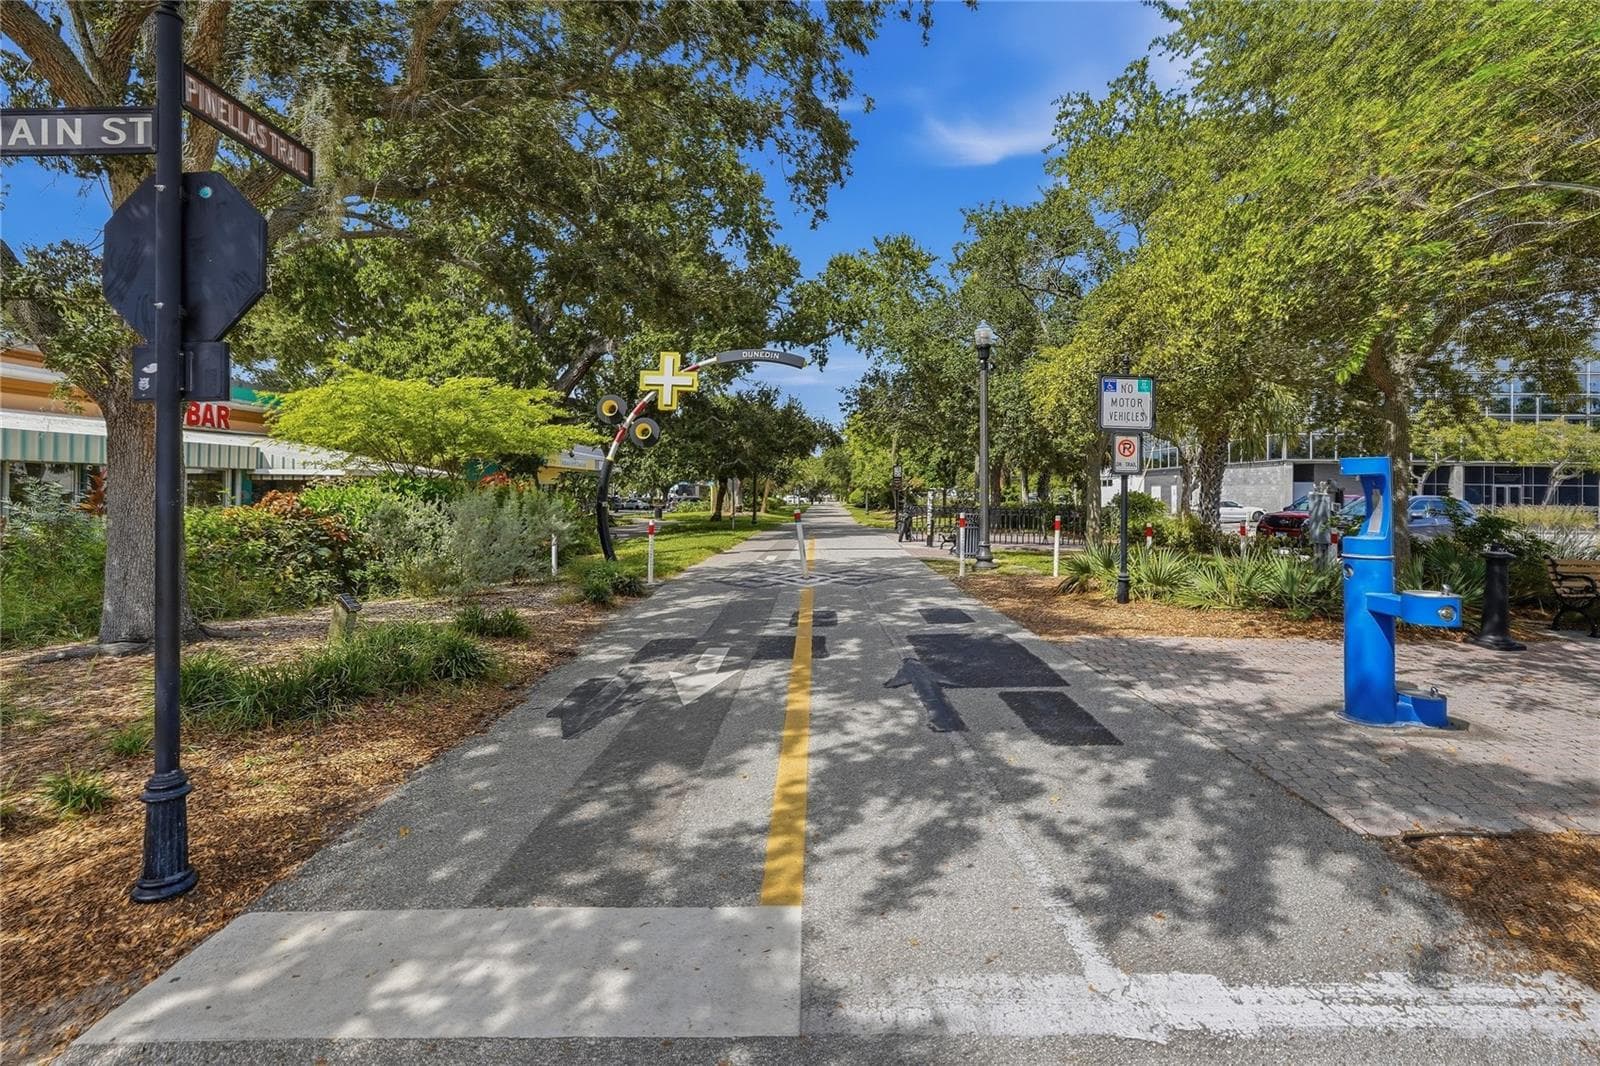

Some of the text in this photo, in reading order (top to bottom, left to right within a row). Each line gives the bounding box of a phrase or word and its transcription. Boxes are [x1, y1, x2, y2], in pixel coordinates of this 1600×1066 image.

[185, 71, 310, 176] PINELLAS TRAIL
[0, 116, 153, 146] AIN ST
[742, 351, 780, 359] DUNEDIN
[1120, 383, 1134, 394] NO
[1110, 398, 1143, 408] MOTOR
[186, 401, 231, 429] BAR
[1109, 411, 1146, 421] VEHICLES
